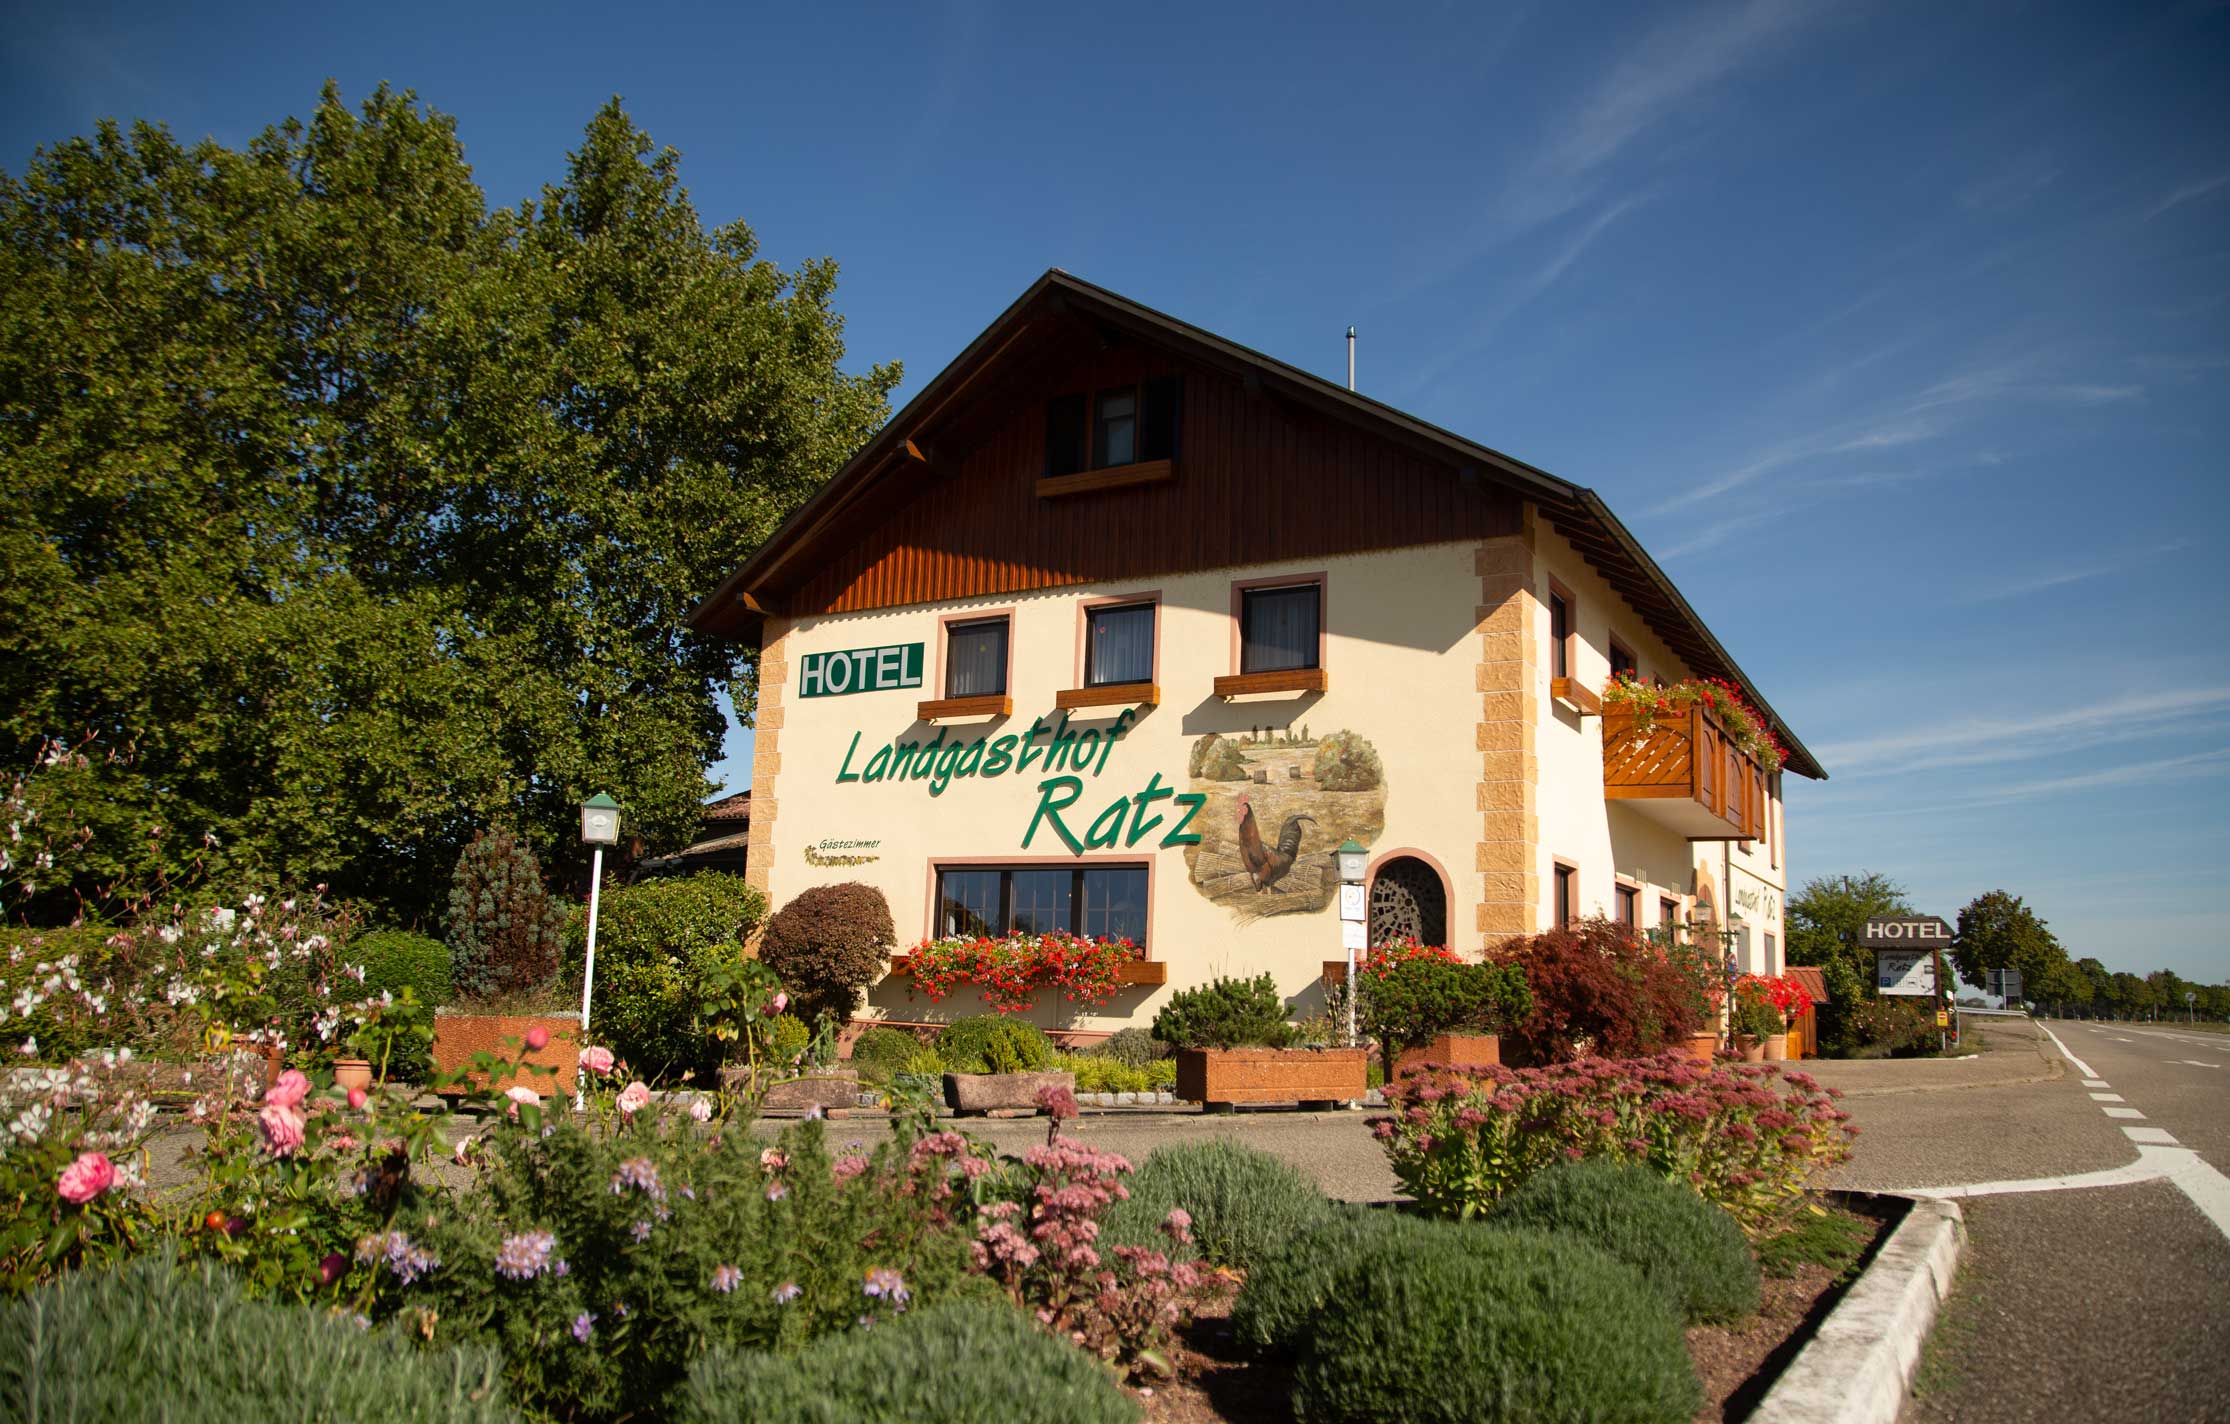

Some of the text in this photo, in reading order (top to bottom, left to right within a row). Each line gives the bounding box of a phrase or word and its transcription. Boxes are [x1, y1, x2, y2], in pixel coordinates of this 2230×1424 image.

[801, 645, 921, 695] HOTEL
[837, 708, 1135, 796] Landgasthof
[1021, 772, 1207, 856] Ratz
[820, 838, 881, 852] Gästezimmer
[1867, 922, 1951, 939] HOTEL
